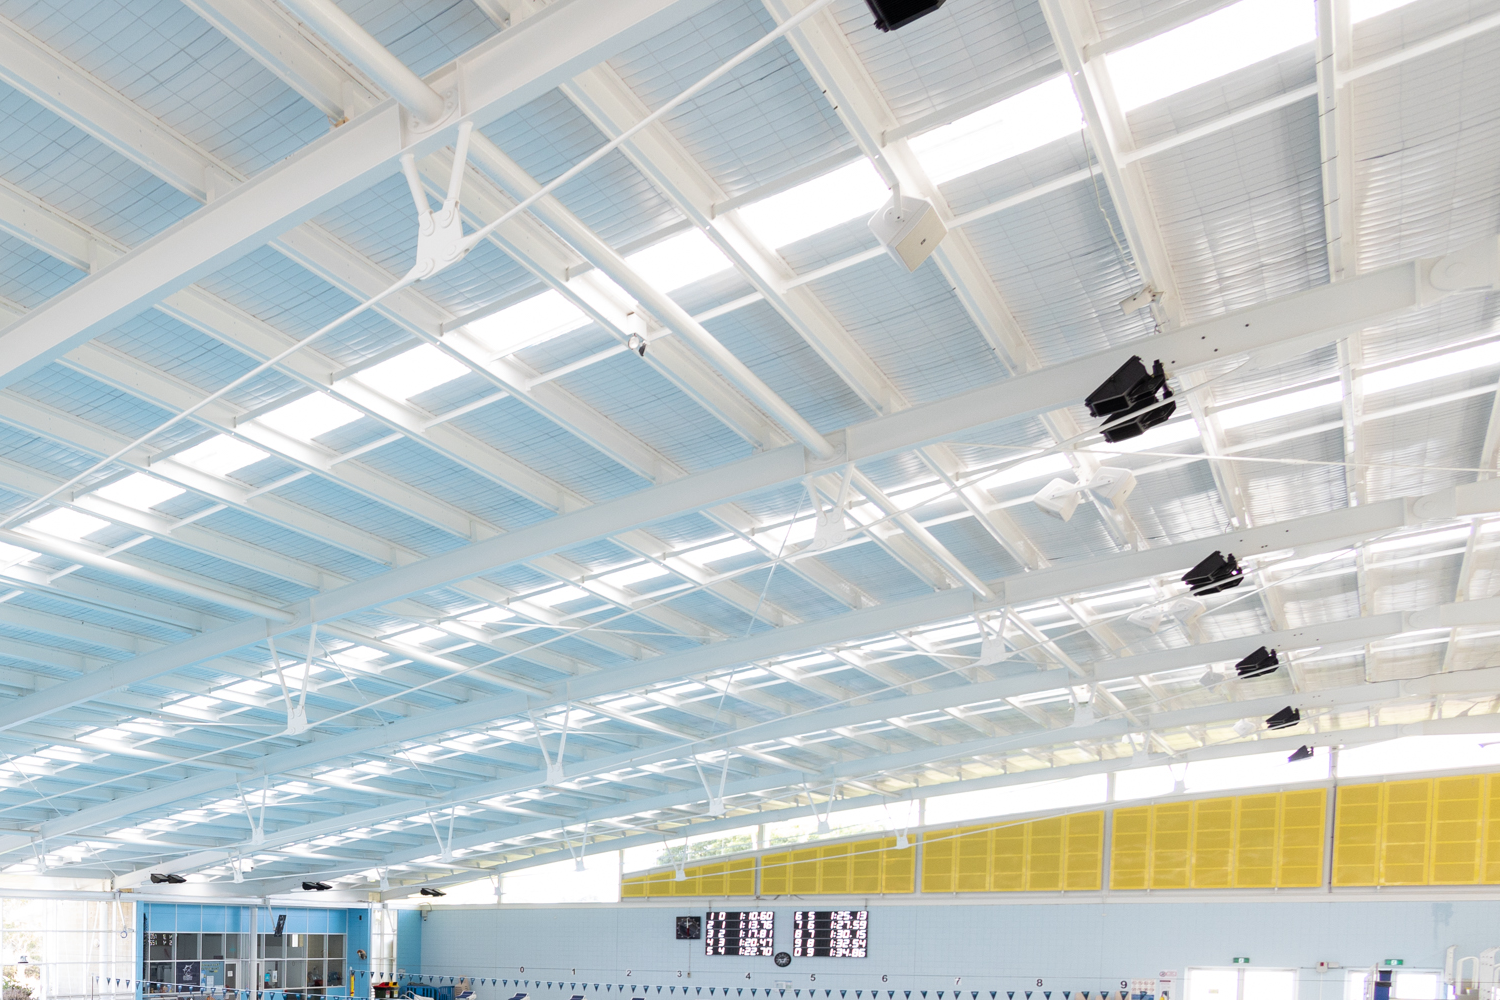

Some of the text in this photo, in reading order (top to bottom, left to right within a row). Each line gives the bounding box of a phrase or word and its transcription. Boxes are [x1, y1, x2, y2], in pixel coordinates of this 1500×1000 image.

[710, 912, 715, 920] 1
[718, 912, 726, 920] 0
[795, 911, 803, 920] 6
[807, 911, 816, 920] 5
[706, 920, 714, 929] 2
[721, 920, 726, 929] 1
[795, 920, 803, 930] 7
[807, 920, 815, 930] 6
[706, 929, 714, 938] 3
[718, 929, 726, 938] 2
[794, 929, 803, 939] 8
[807, 929, 815, 939] 7
[706, 938, 714, 947] 4
[718, 938, 726, 947] 3
[794, 938, 802, 948] 9
[806, 938, 815, 948] 8
[706, 947, 714, 956] 5
[718, 947, 725, 956] 4
[793, 947, 802, 957] 0
[806, 947, 815, 957] 9
[626, 969, 632, 977] 2
[677, 970, 682, 978] 3
[745, 972, 751, 980] 4
[810, 973, 816, 982] 5
[882, 974, 888, 983] 6
[1036, 978, 1043, 988] 8
[1120, 980, 1128, 989] 9
